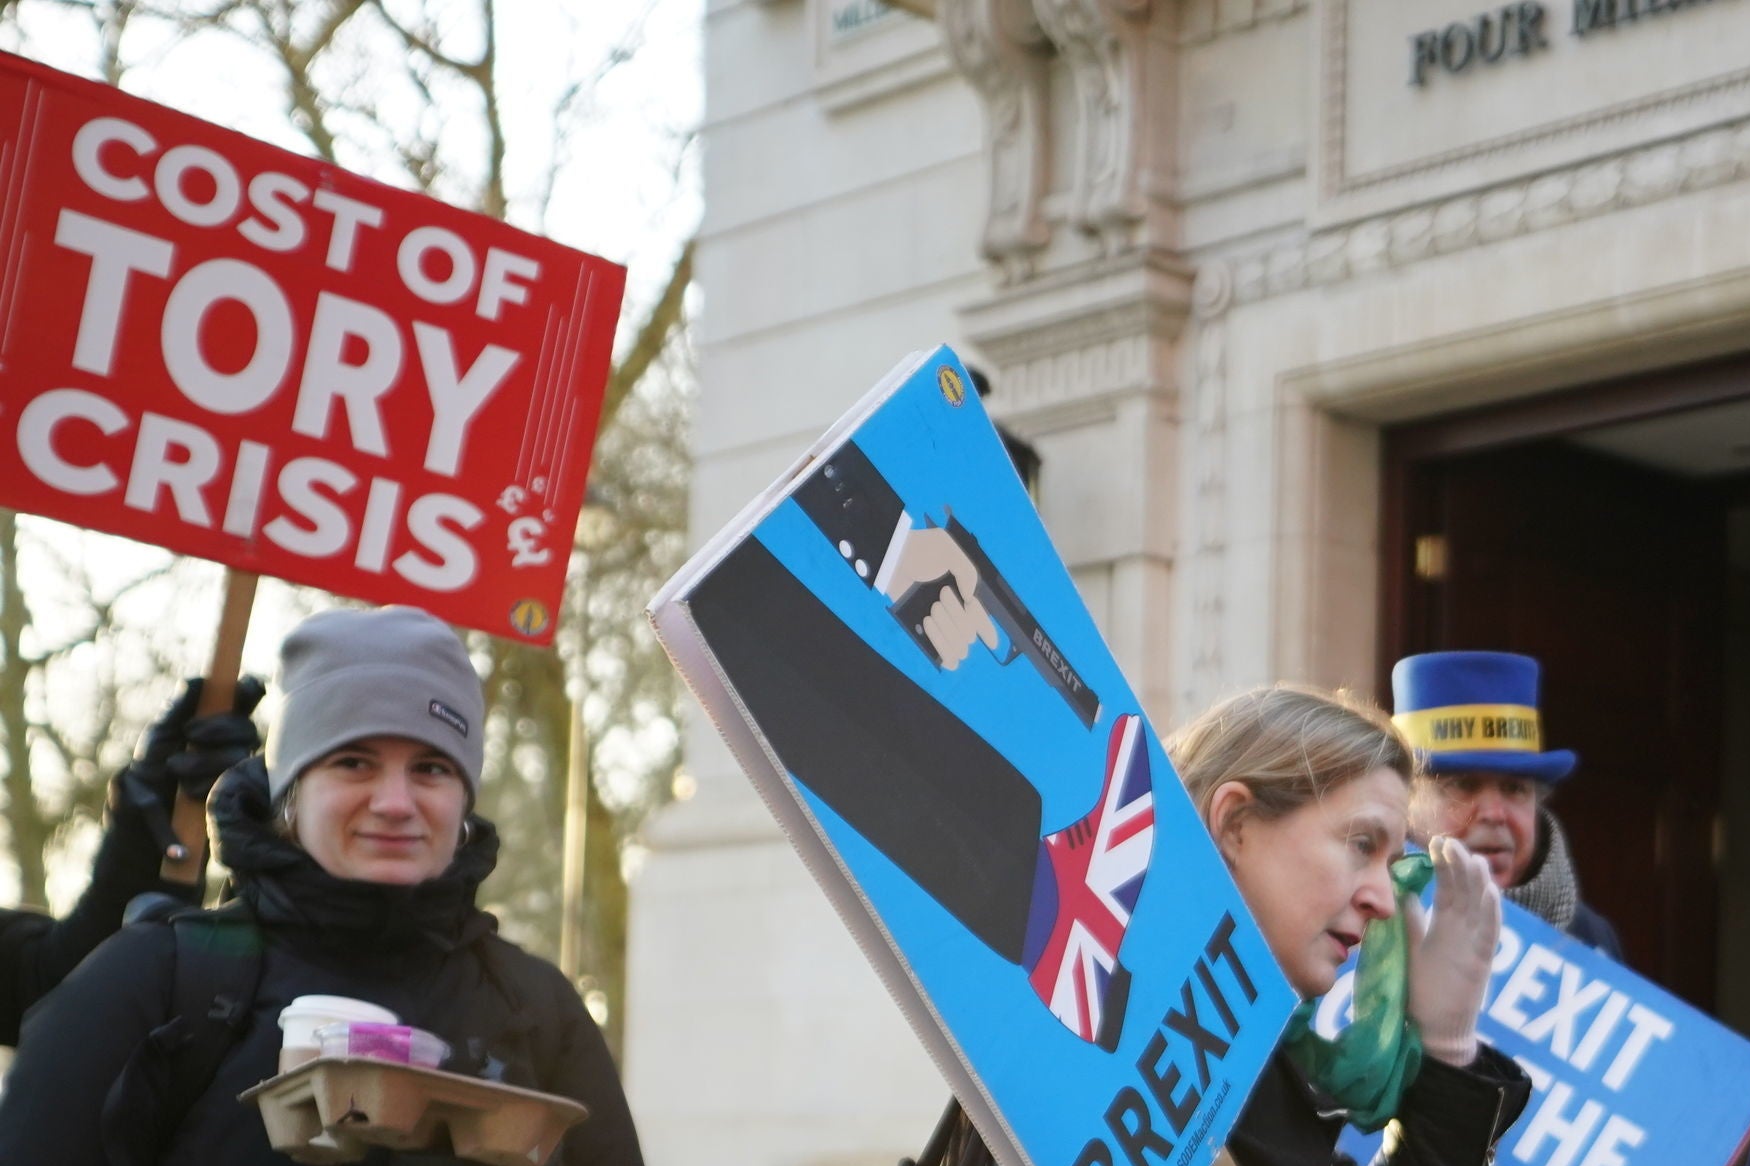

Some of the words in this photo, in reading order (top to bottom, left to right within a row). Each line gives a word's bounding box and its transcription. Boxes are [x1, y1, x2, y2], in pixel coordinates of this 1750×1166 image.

[1407, 1, 1548, 86] FOUR
[72, 116, 383, 272] COST
[396, 226, 540, 321] OF
[53, 207, 520, 478] TORY
[16, 387, 485, 592] CRISIS
[1032, 627, 1082, 693] BREXIT
[1431, 716, 1475, 741] WHY
[1478, 922, 1675, 1093] REXIT
